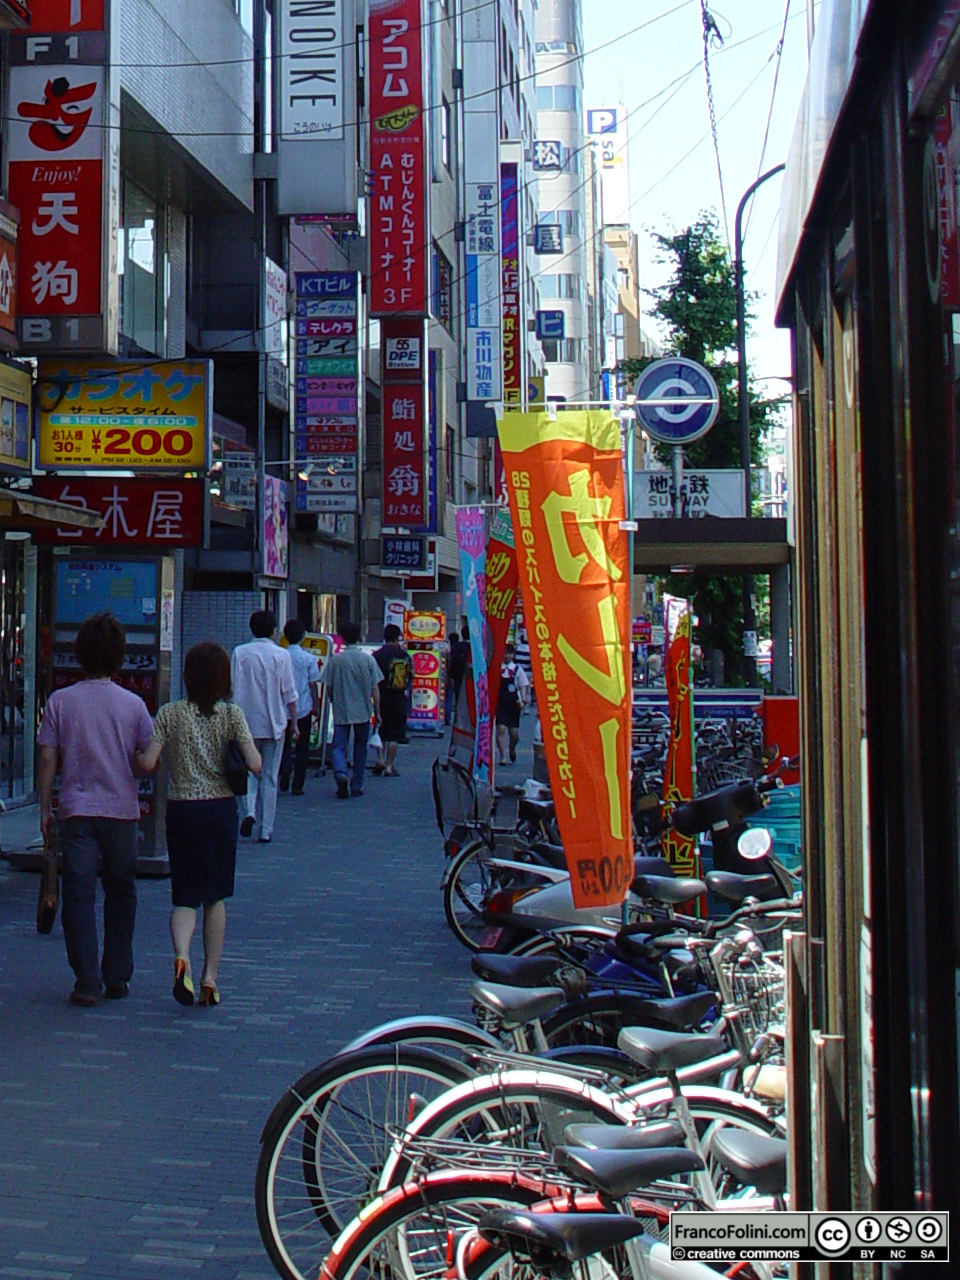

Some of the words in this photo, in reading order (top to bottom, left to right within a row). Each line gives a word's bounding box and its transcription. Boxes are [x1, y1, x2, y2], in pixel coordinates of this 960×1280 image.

[381, 18, 410, 98] アコム
[534, 143, 561, 166] 松
[30, 165, 82, 186] Enjoy!
[379, 152, 395, 282] ATMコーナー
[400, 152, 416, 282] むじんくんコーナー
[30, 191, 80, 307] 天狗
[537, 226, 561, 251] 屋
[301, 276, 351, 293] KTビル
[309, 321, 354, 334] テレクラ
[388, 351, 419, 361] DPE
[475, 330, 492, 398] 市川物産
[43, 369, 204, 403] カラオケ
[69, 405, 177, 416] サービスタイム
[51, 429, 84, 441] お1人様
[53, 441, 82, 453] 30分
[387, 503, 422, 516] おきな
[386, 553, 420, 565] クリニック
